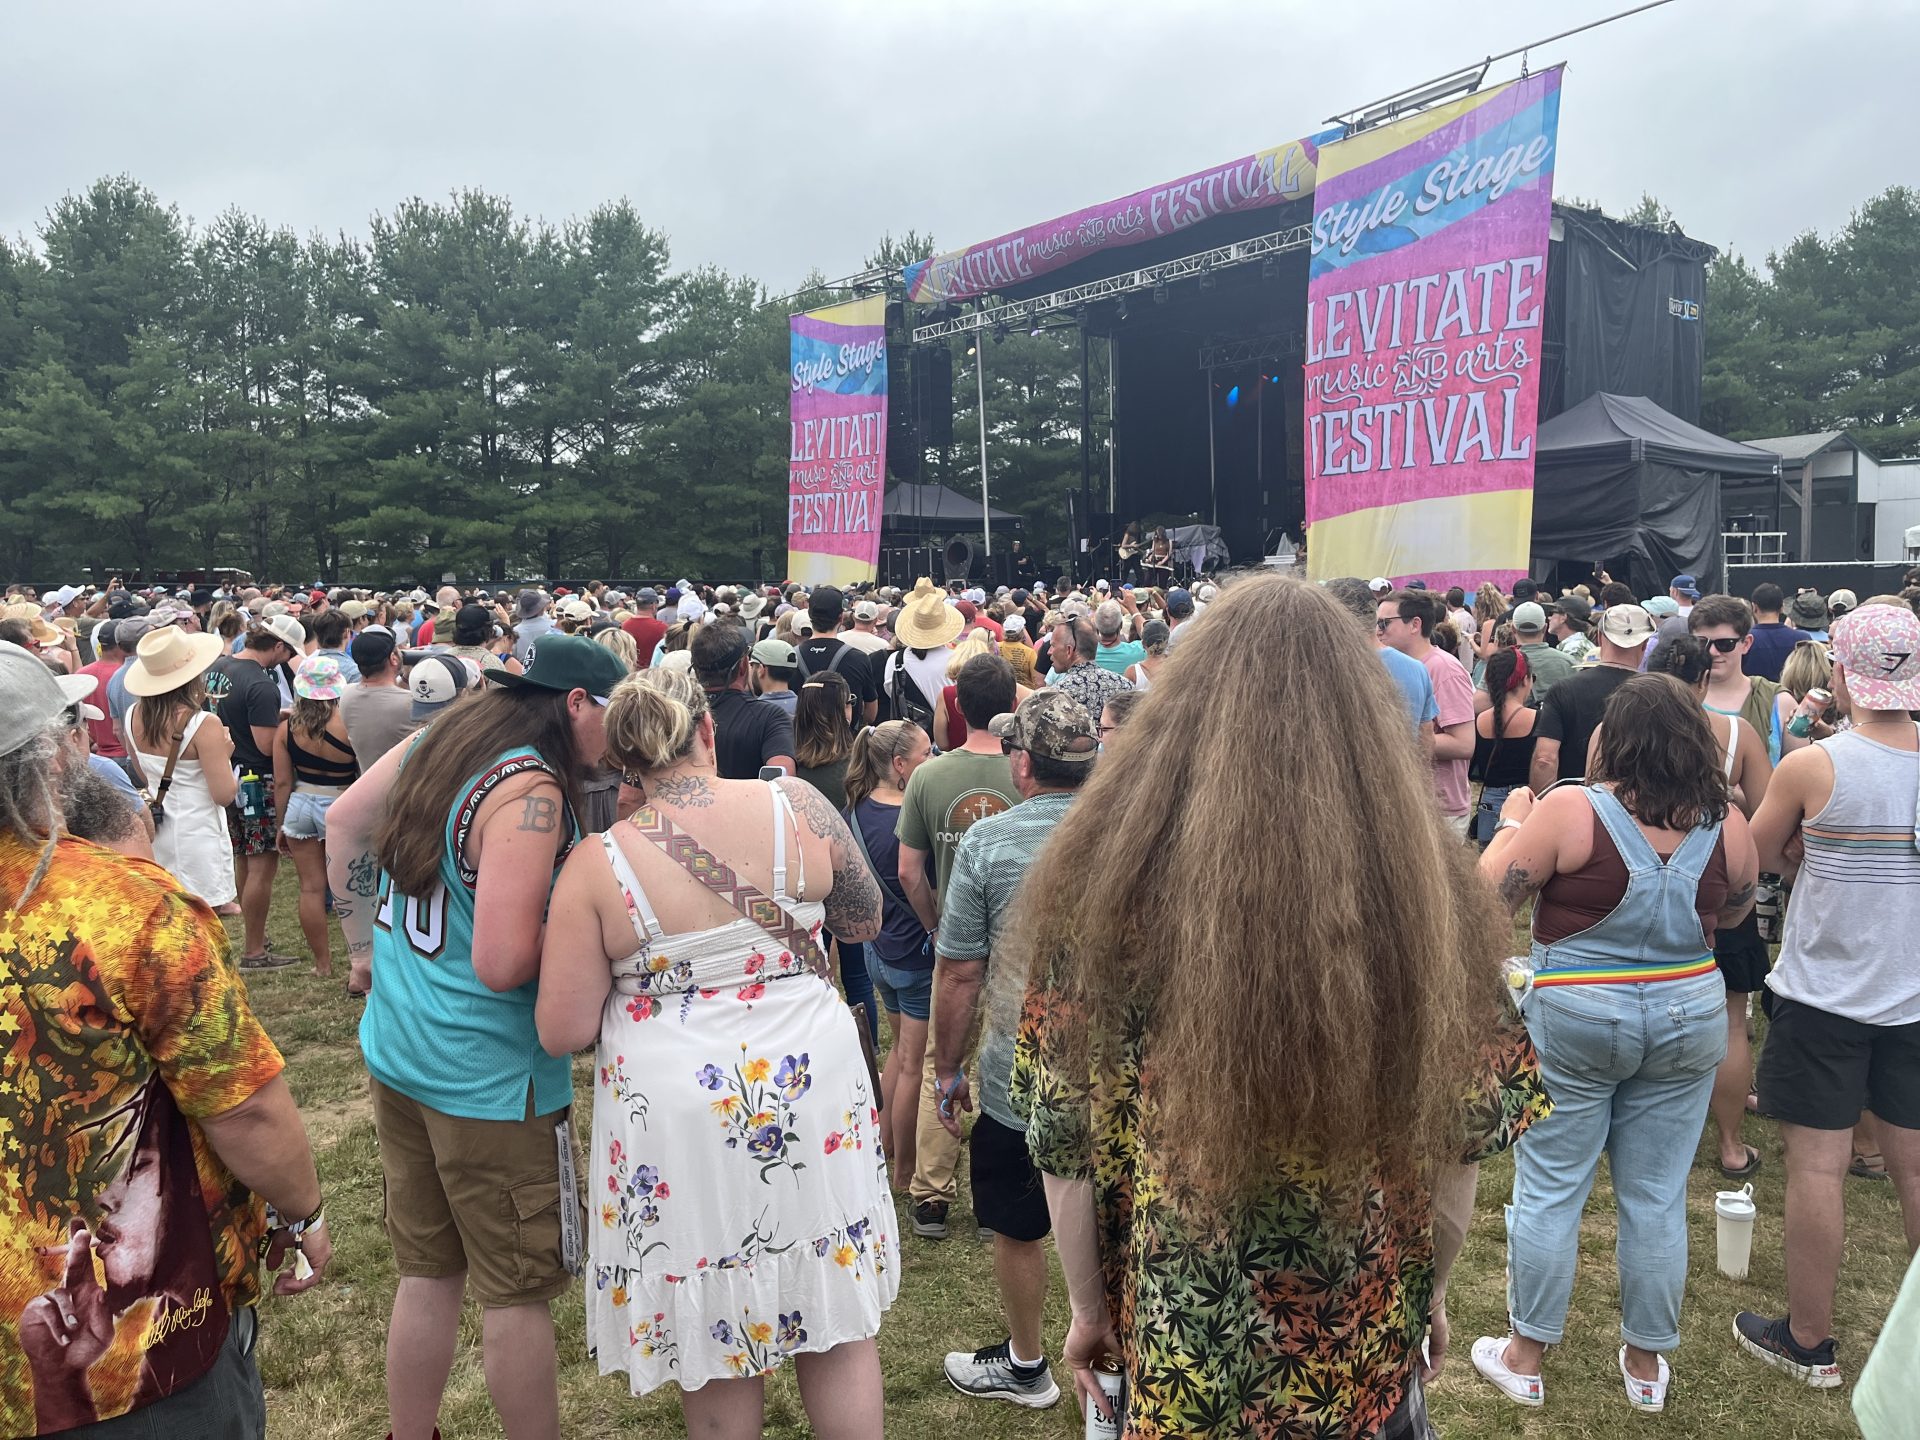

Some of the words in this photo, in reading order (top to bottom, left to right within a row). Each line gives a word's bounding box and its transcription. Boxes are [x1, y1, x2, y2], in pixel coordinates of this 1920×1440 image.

[925, 236, 1033, 301] LEVITATE
[1027, 226, 1077, 260] music
[1107, 202, 1146, 236] arts
[1151, 146, 1300, 235] FESTIVAL
[1310, 185, 1409, 256] Style
[1413, 135, 1553, 217] Stage
[1306, 256, 1544, 366] LEVITATE
[791, 352, 834, 396] Style
[836, 335, 884, 378] Stage
[1307, 352, 1389, 406] music
[1392, 345, 1449, 397] AND
[1454, 331, 1534, 388] arts
[788, 490, 878, 535] FESTIVA
